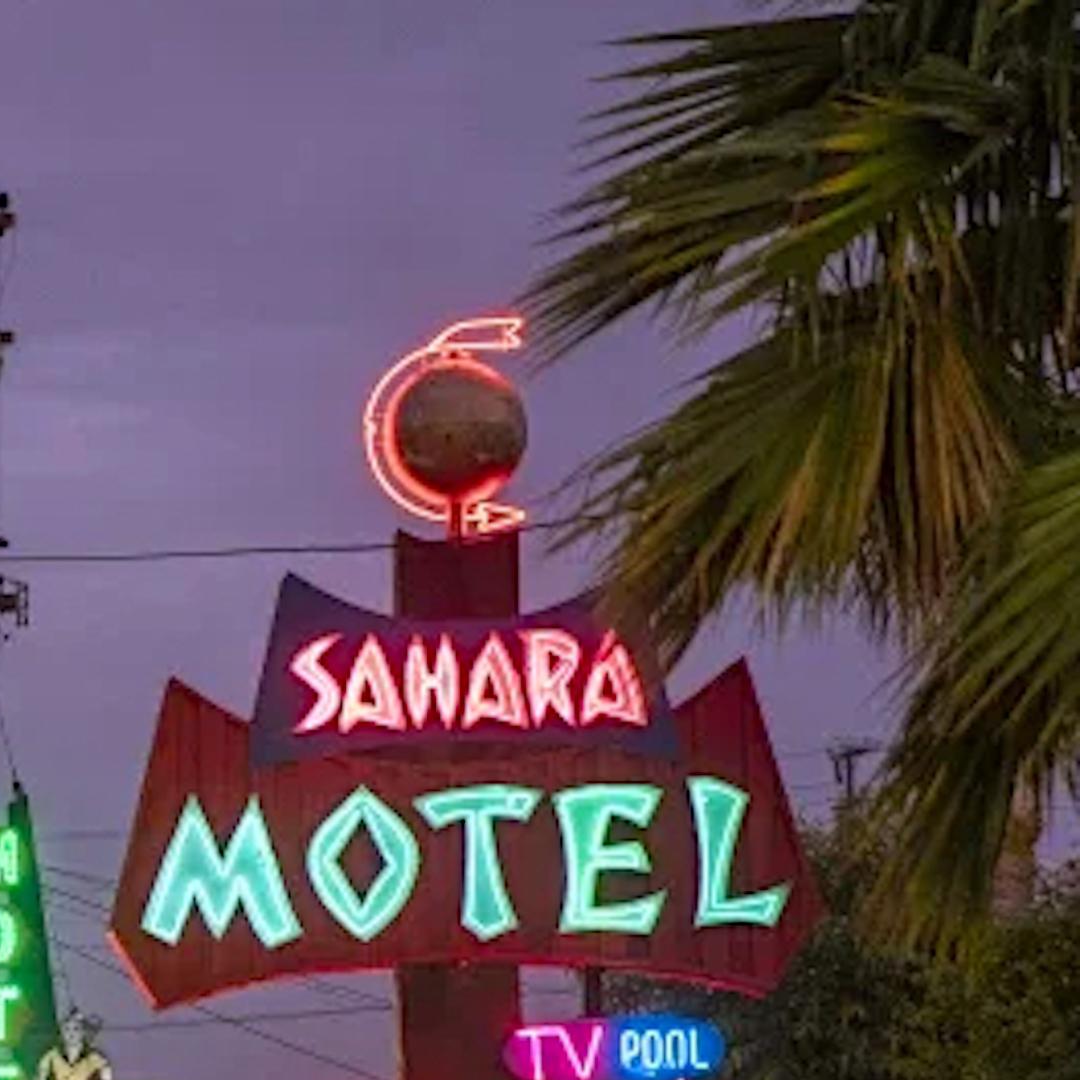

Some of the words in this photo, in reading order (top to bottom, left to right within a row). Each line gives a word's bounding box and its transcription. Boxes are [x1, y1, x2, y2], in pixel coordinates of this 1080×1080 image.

[289, 628, 649, 735] SAHARA
[139, 774, 791, 950] MOTEL
[621, 1028, 710, 1072] POOL
